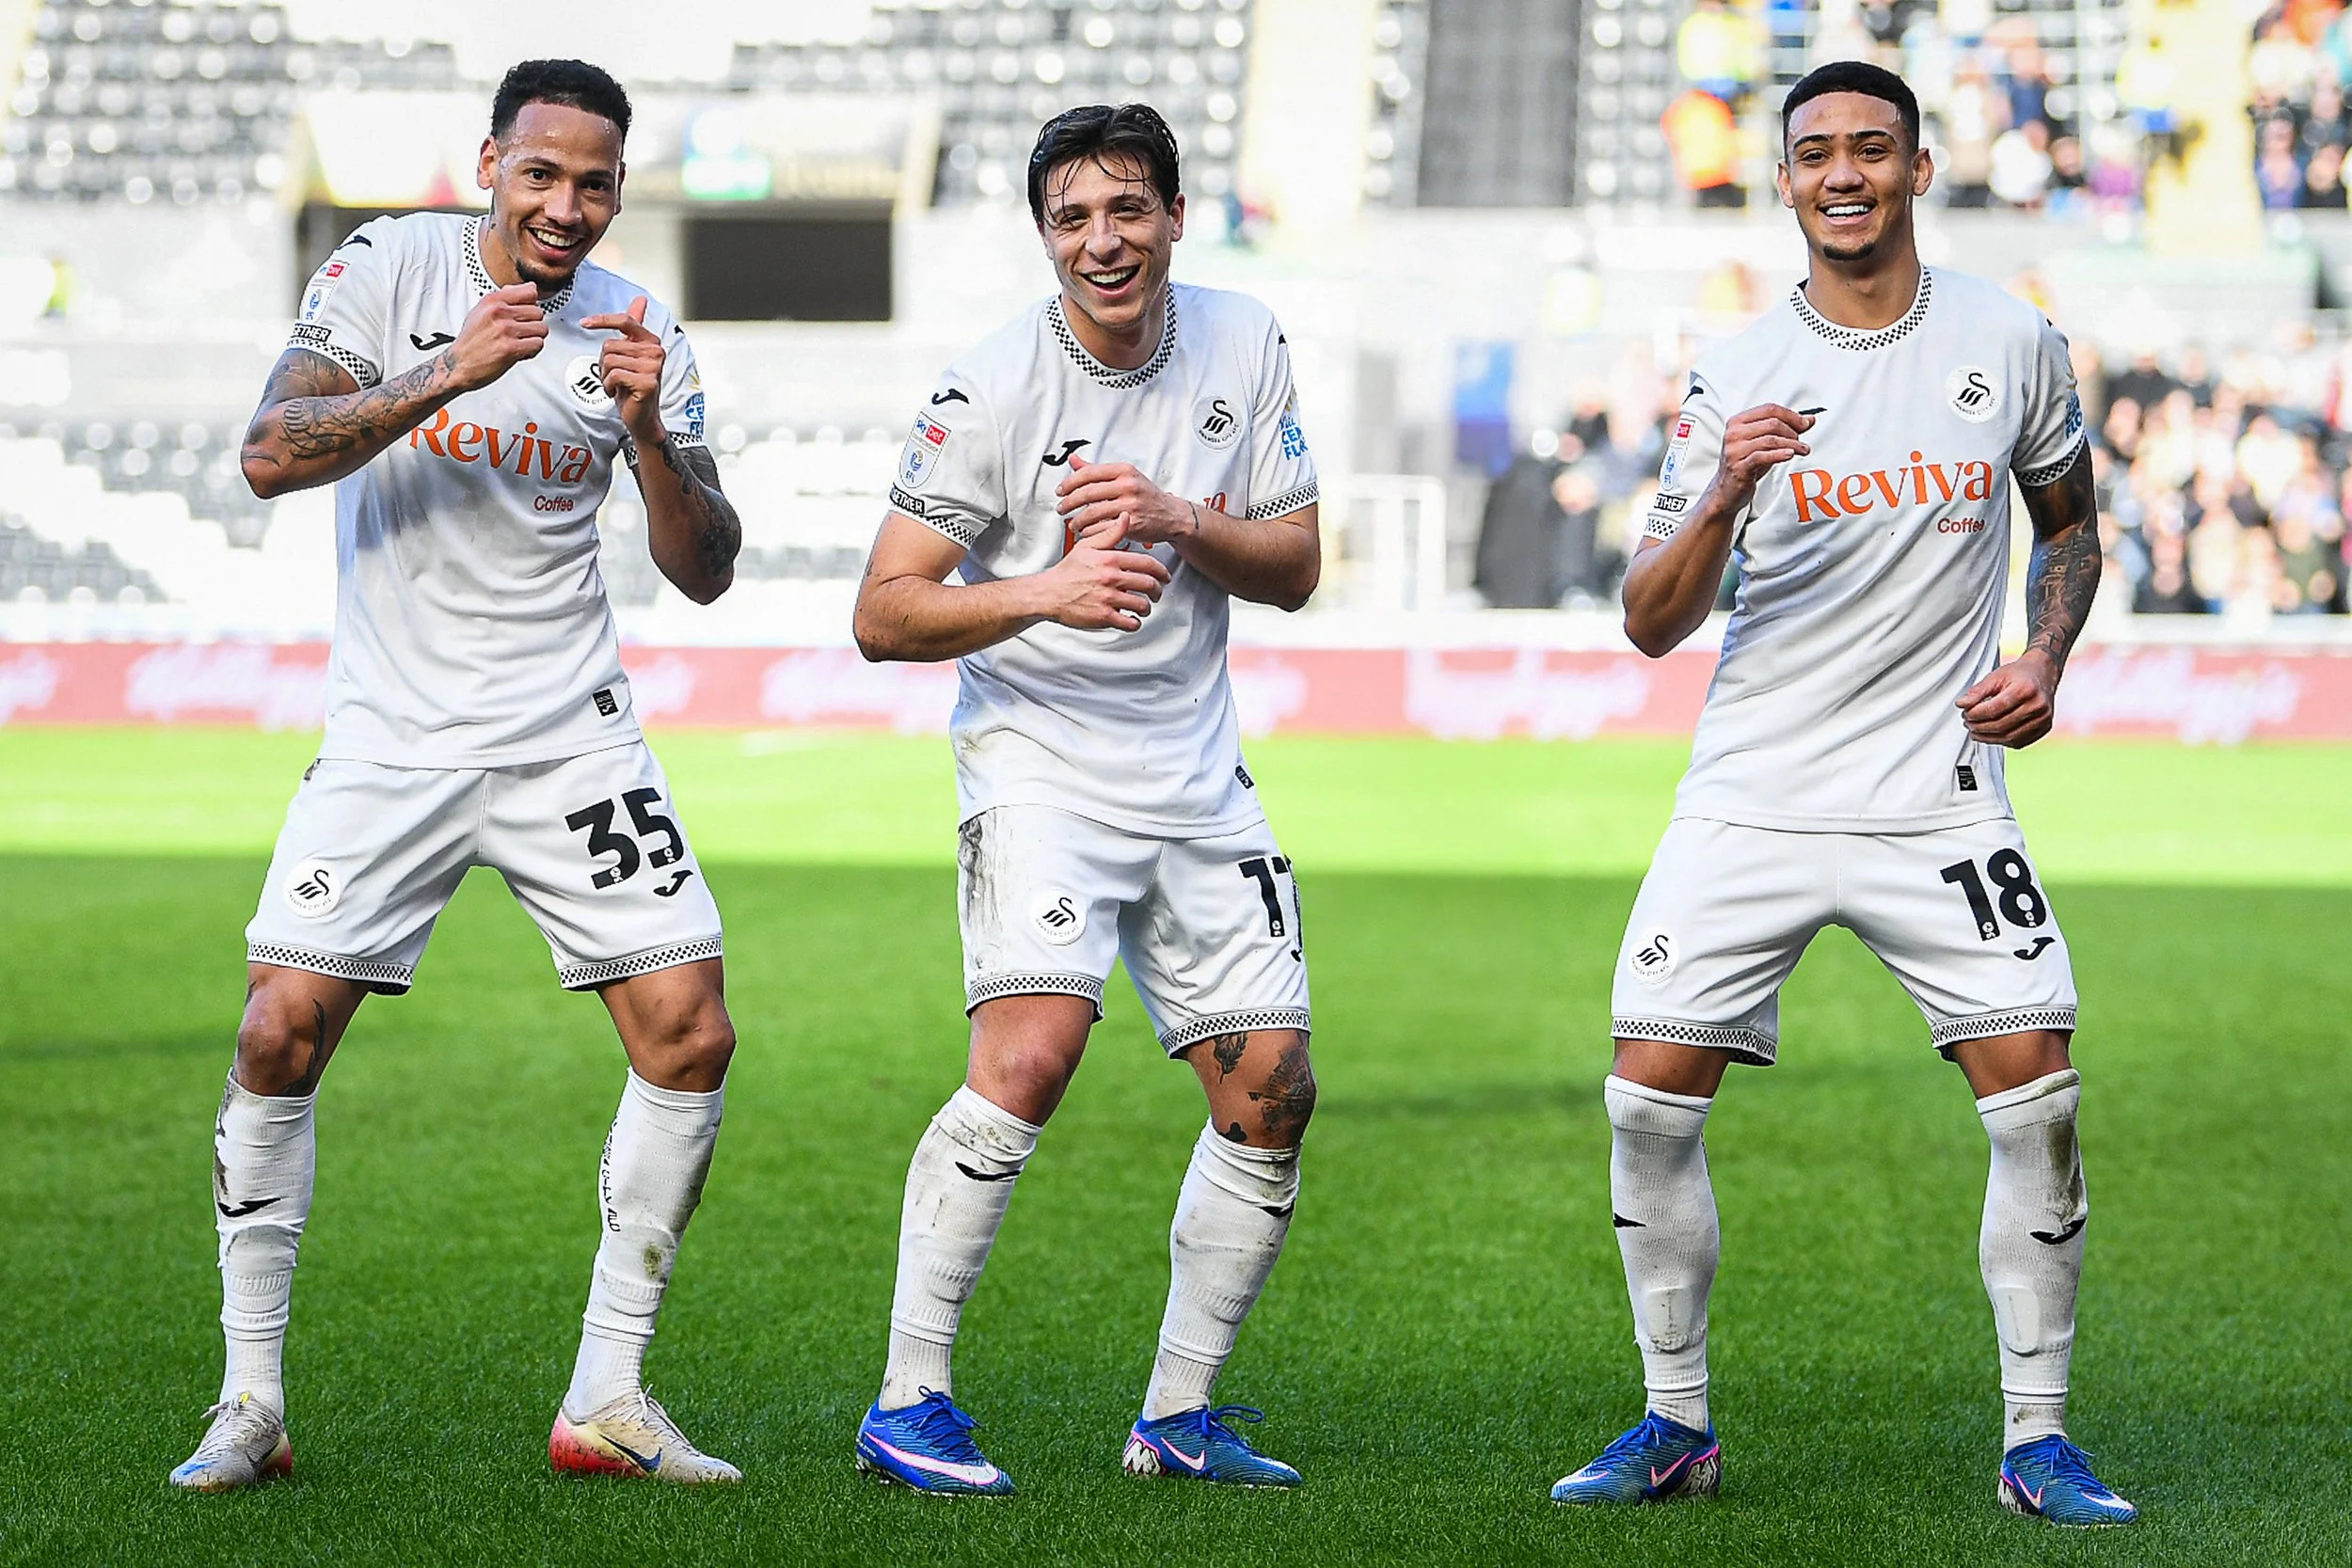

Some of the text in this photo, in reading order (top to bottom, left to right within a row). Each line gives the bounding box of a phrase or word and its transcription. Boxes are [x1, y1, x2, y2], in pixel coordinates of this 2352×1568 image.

[409, 406, 594, 483] Reviva
[533, 495, 574, 512] Coffee
[1789, 451, 1993, 523] Reviva
[1937, 517, 1986, 534] Coffee
[564, 786, 684, 891] 35
[1940, 847, 2047, 942] 18
